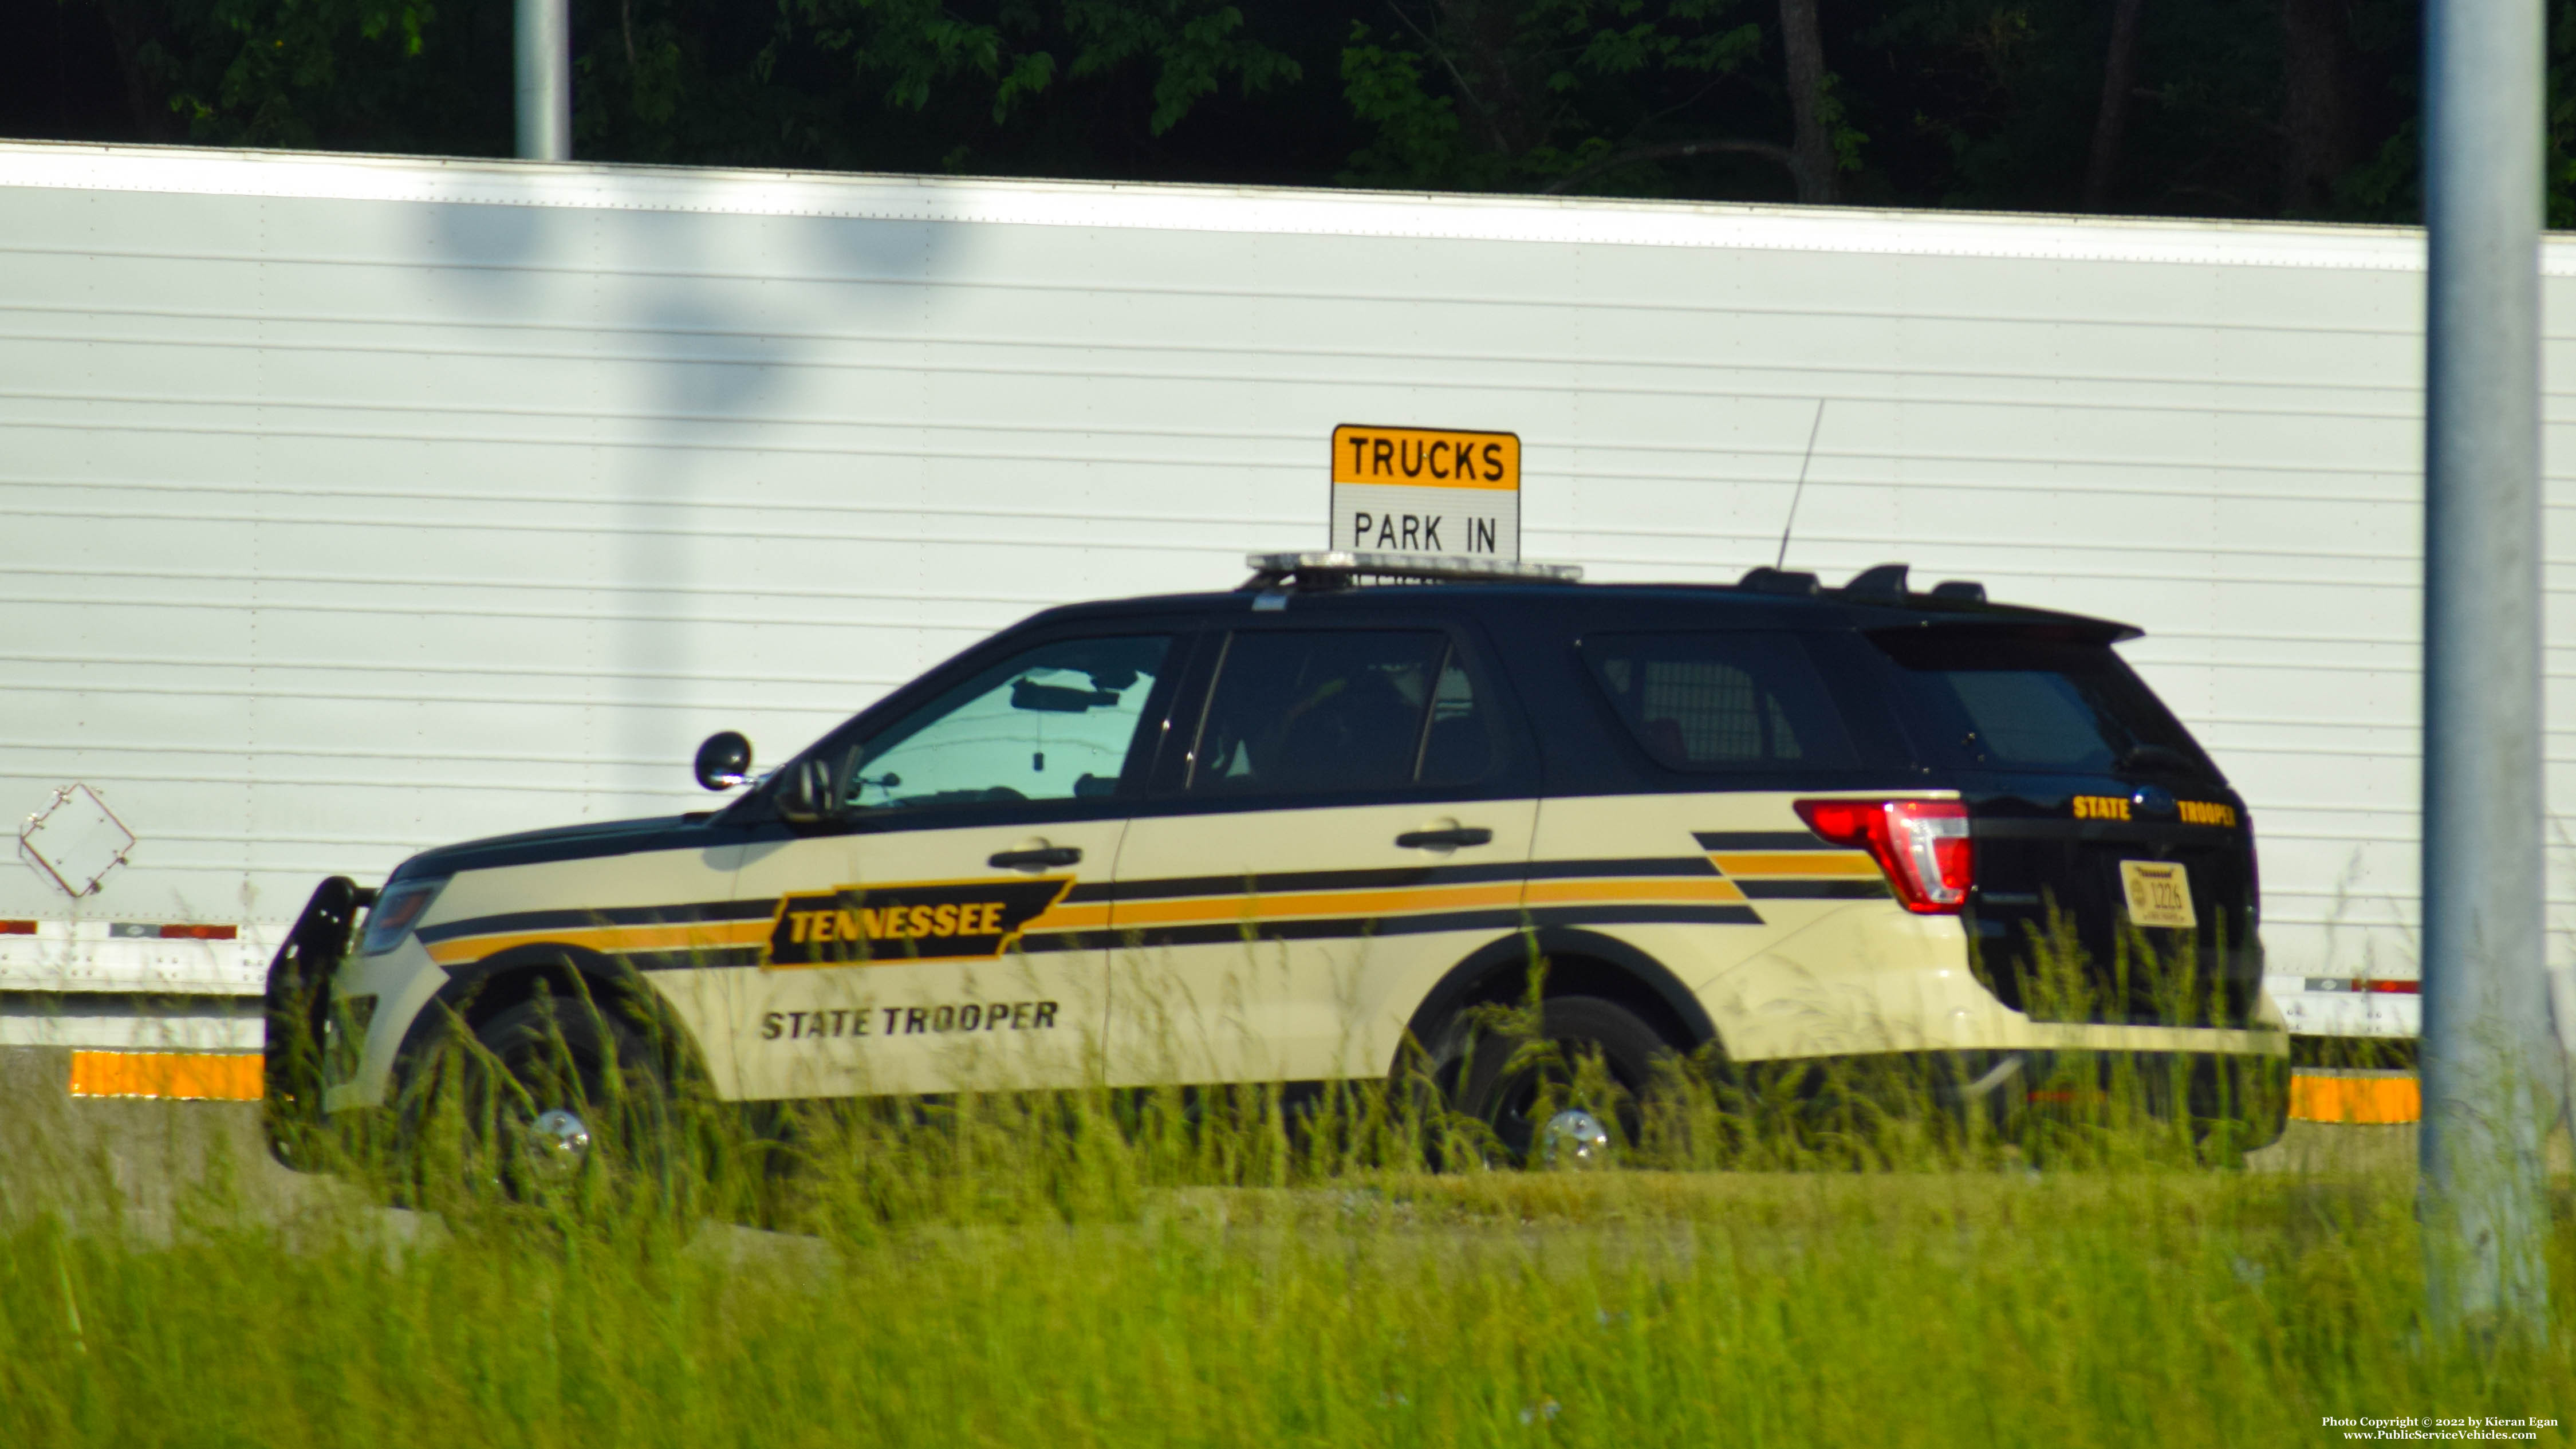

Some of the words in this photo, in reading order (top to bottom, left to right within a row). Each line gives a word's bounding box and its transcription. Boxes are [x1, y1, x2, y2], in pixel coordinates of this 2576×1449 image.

[1349, 437, 1504, 481] TRUCKS
[1354, 511, 1442, 551] PARK
[1468, 517, 1496, 553] IN
[2073, 796, 2132, 820] STATE
[787, 902, 1006, 943] TENNESSEE
[762, 1007, 871, 1040] STATE
[883, 1001, 1059, 1035] TROOPER
